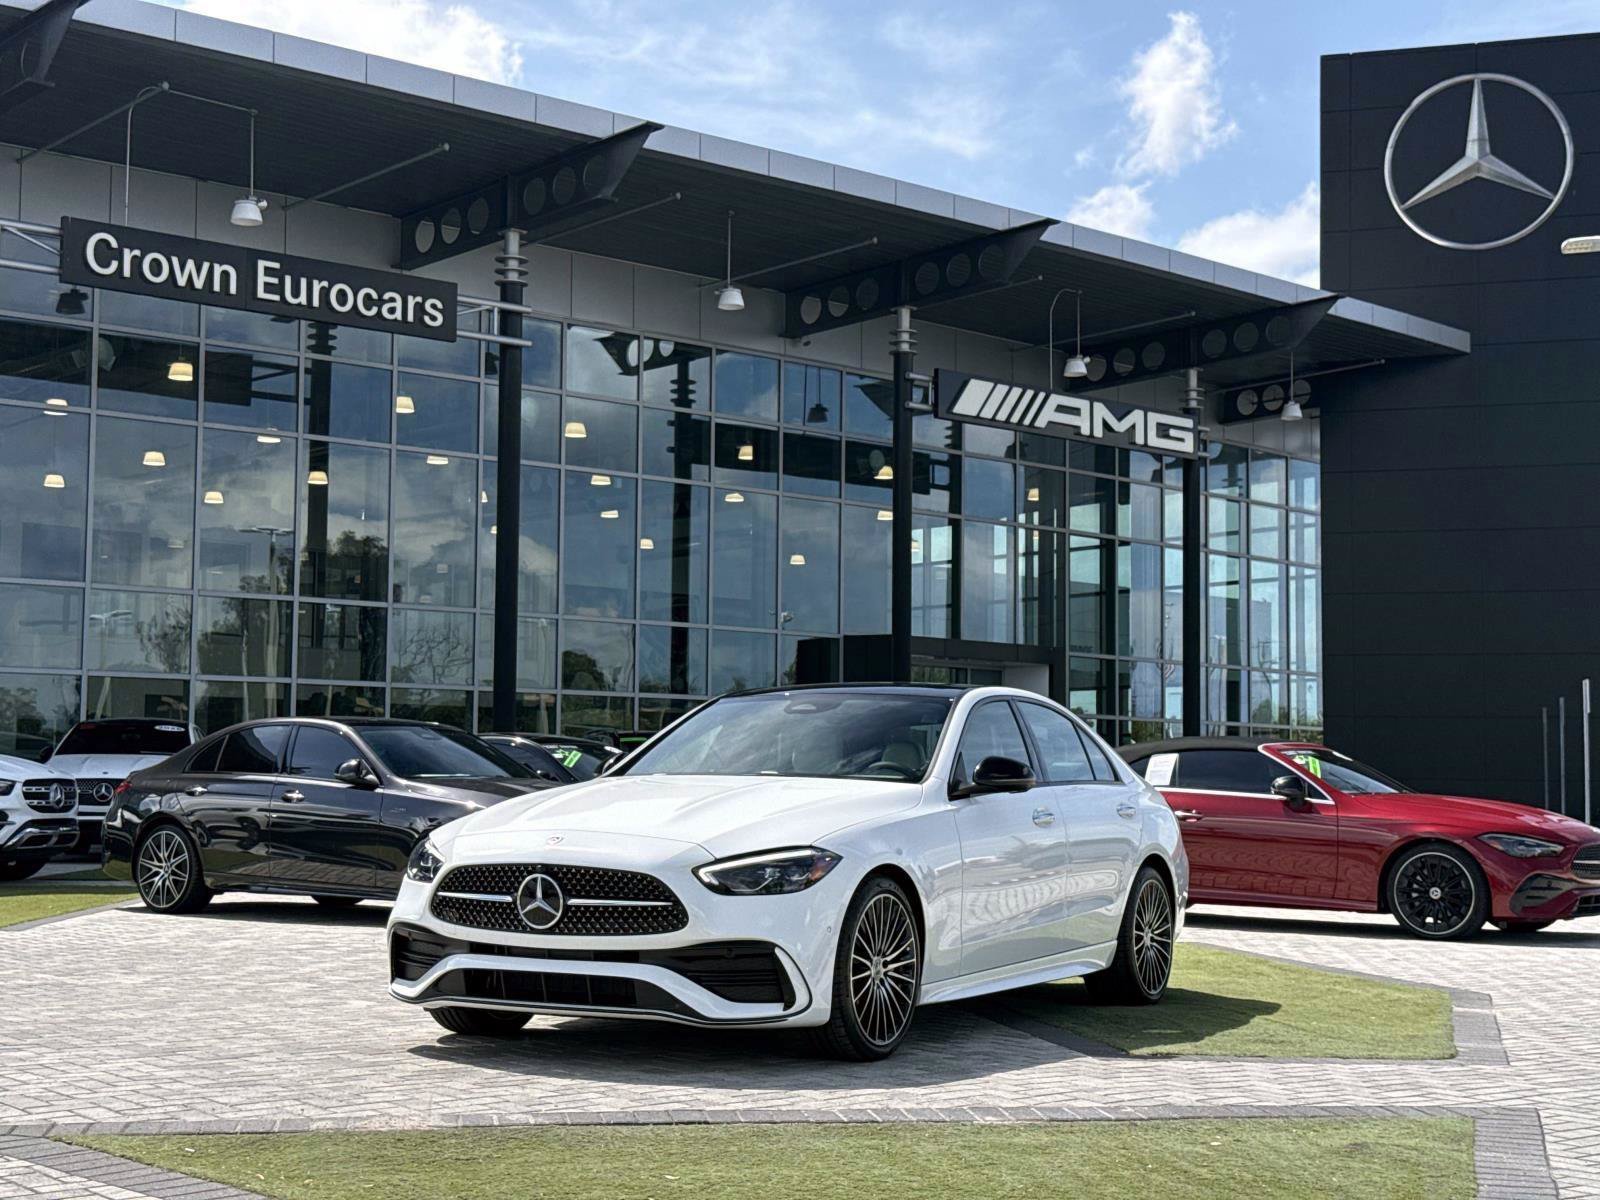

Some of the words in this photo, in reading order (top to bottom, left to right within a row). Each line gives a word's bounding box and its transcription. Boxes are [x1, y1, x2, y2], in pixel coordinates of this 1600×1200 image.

[85, 231, 238, 295] Crown
[256, 259, 444, 327] Eurocars
[1034, 393, 1194, 453] AMG
